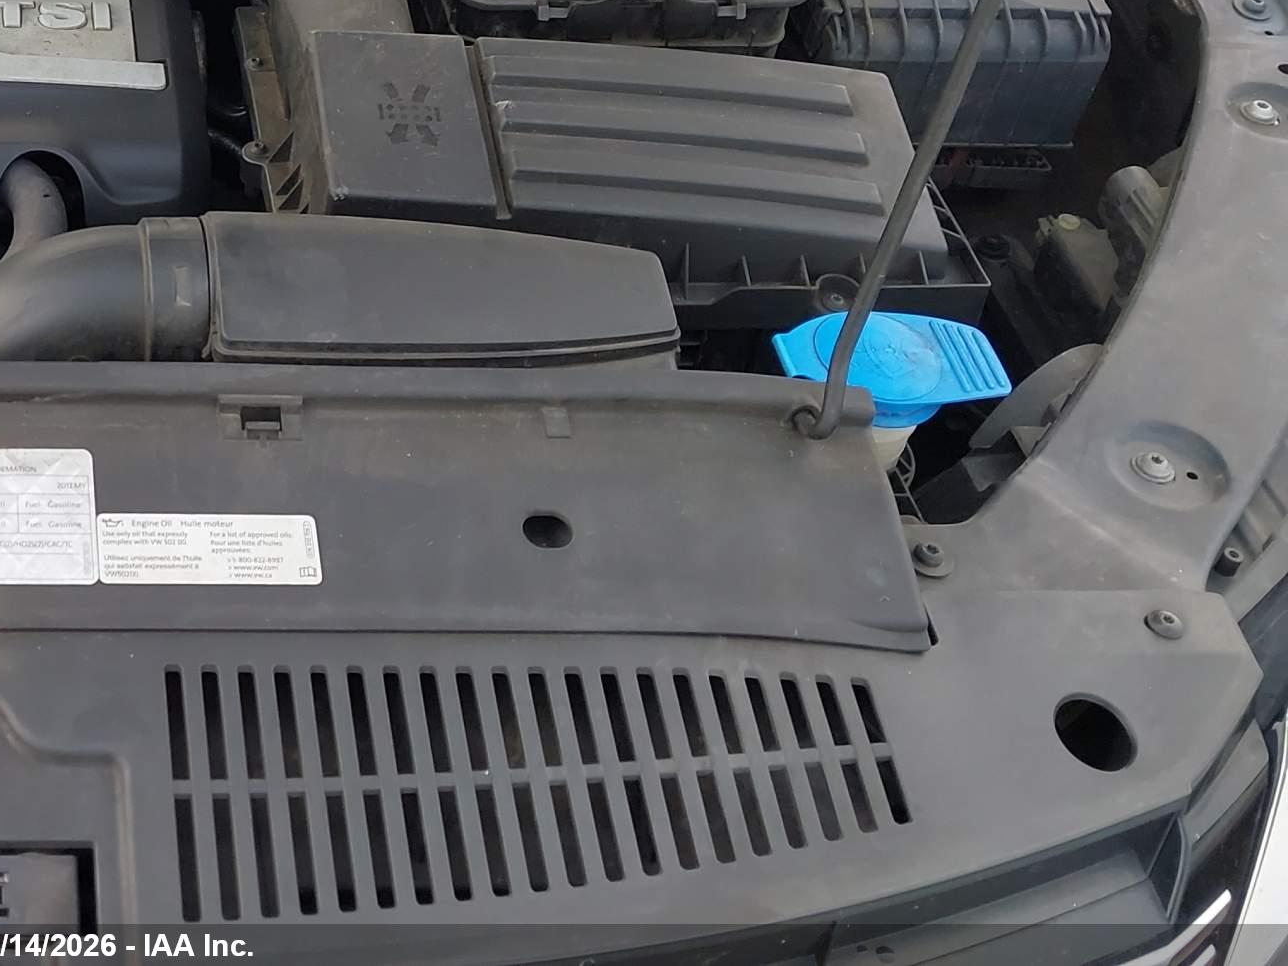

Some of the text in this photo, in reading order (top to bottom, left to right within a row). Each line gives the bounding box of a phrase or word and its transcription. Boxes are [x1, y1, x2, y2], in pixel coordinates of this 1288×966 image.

[132, 520, 160, 529] Engine
[116, 531, 131, 539] only
[247, 531, 278, 539] approved
